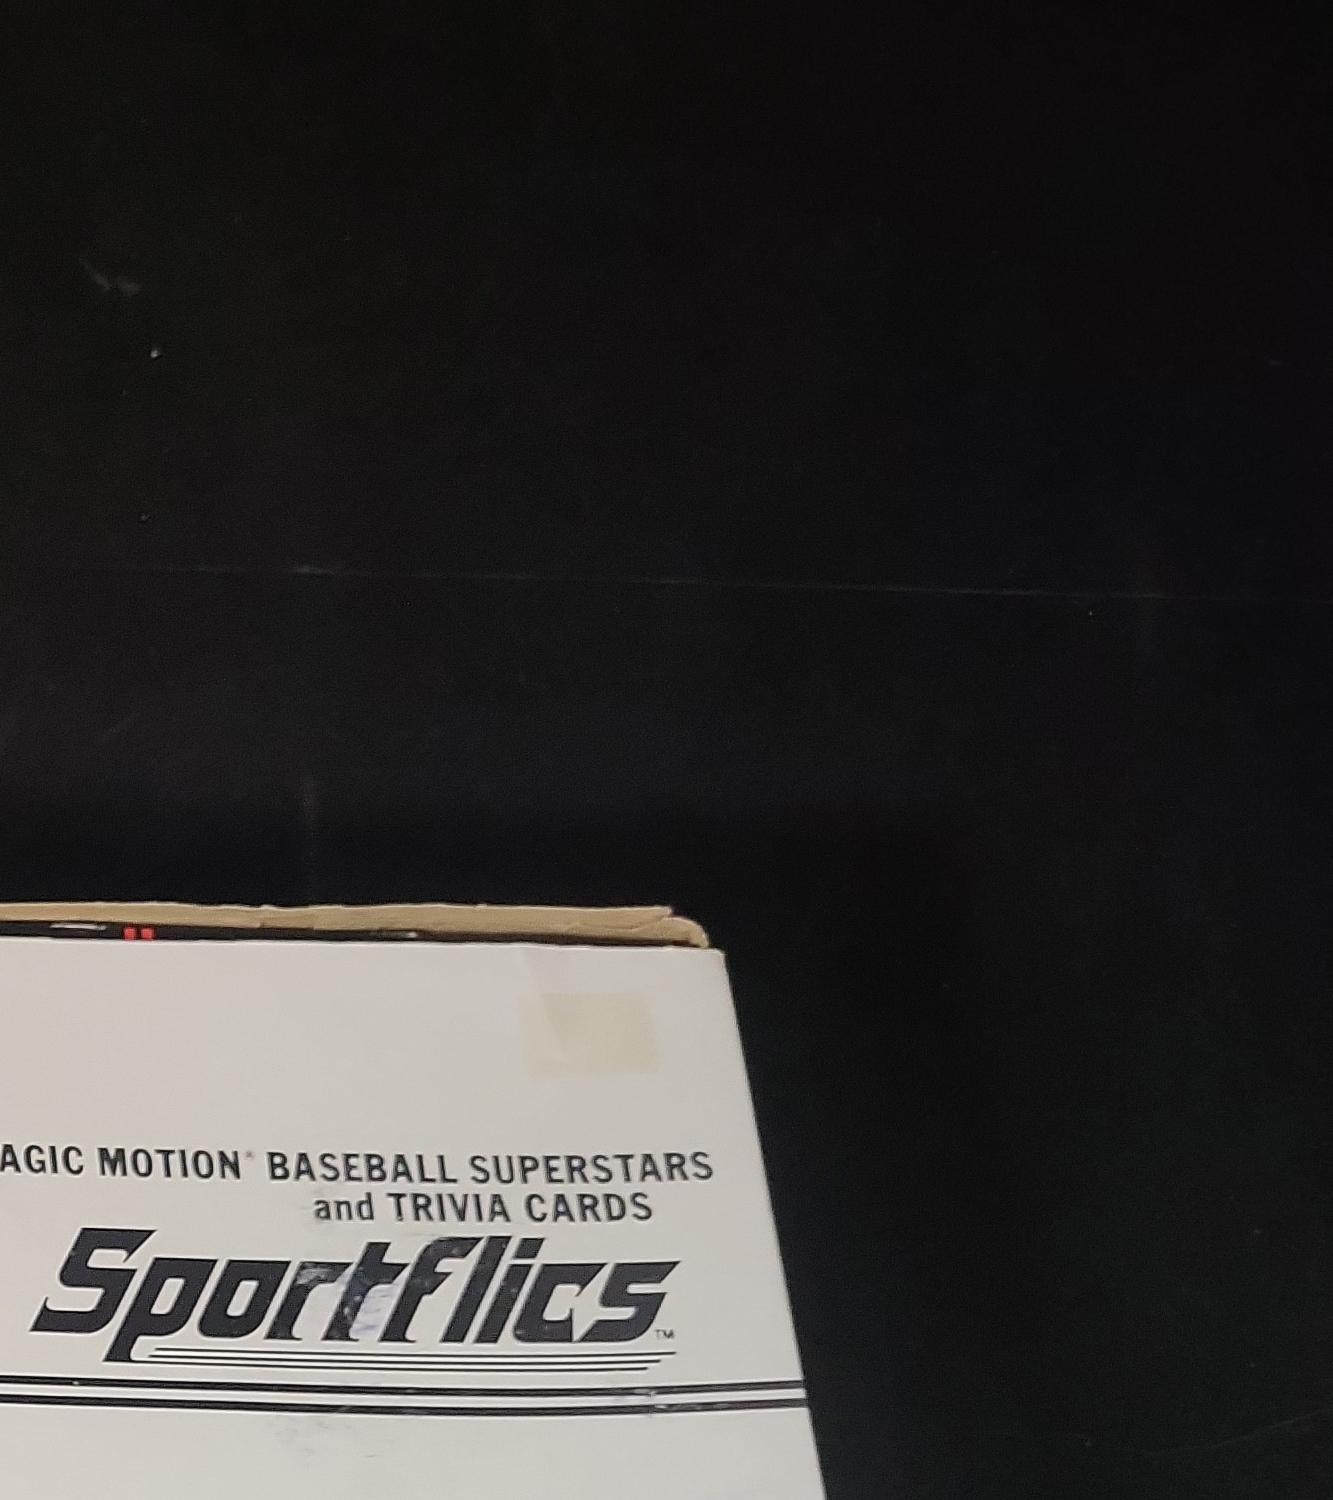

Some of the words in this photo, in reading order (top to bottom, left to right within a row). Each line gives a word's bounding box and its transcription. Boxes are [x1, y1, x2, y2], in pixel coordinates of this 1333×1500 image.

[268, 1149, 459, 1184] BASEBALL
[470, 1151, 715, 1184] SUPERSTARS
[313, 1193, 375, 1222] and
[386, 1193, 512, 1225] TRIVIA
[525, 1192, 655, 1224] CARDS
[29, 1226, 682, 1363] Sportflics
